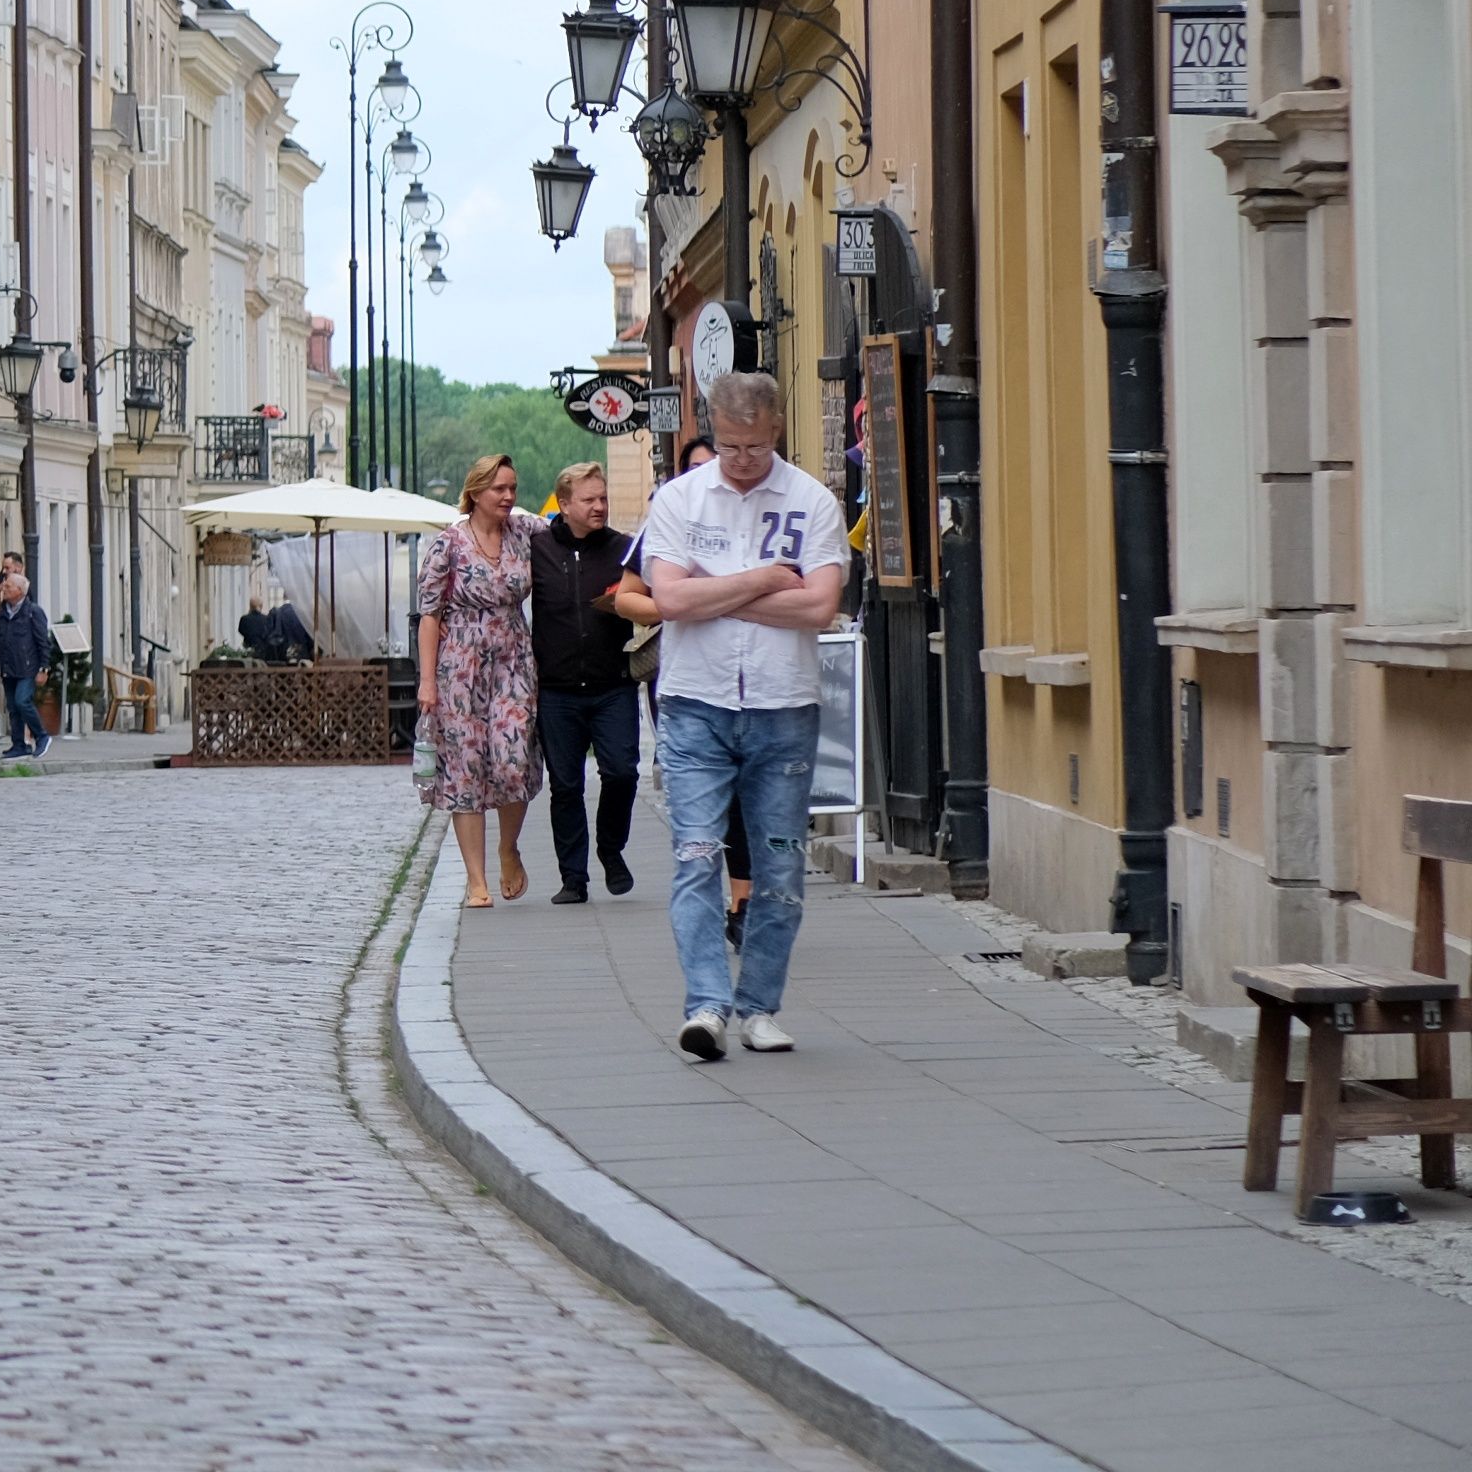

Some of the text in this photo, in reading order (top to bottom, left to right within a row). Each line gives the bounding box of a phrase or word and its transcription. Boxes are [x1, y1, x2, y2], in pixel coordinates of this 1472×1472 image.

[1180, 23, 1212, 67] 26
[843, 221, 864, 249] 30
[853, 250, 875, 260] ULICA
[853, 261, 875, 271] FRETA
[651, 397, 678, 416] 34 36
[588, 417, 638, 435] BORUTA
[759, 511, 807, 560] 25
